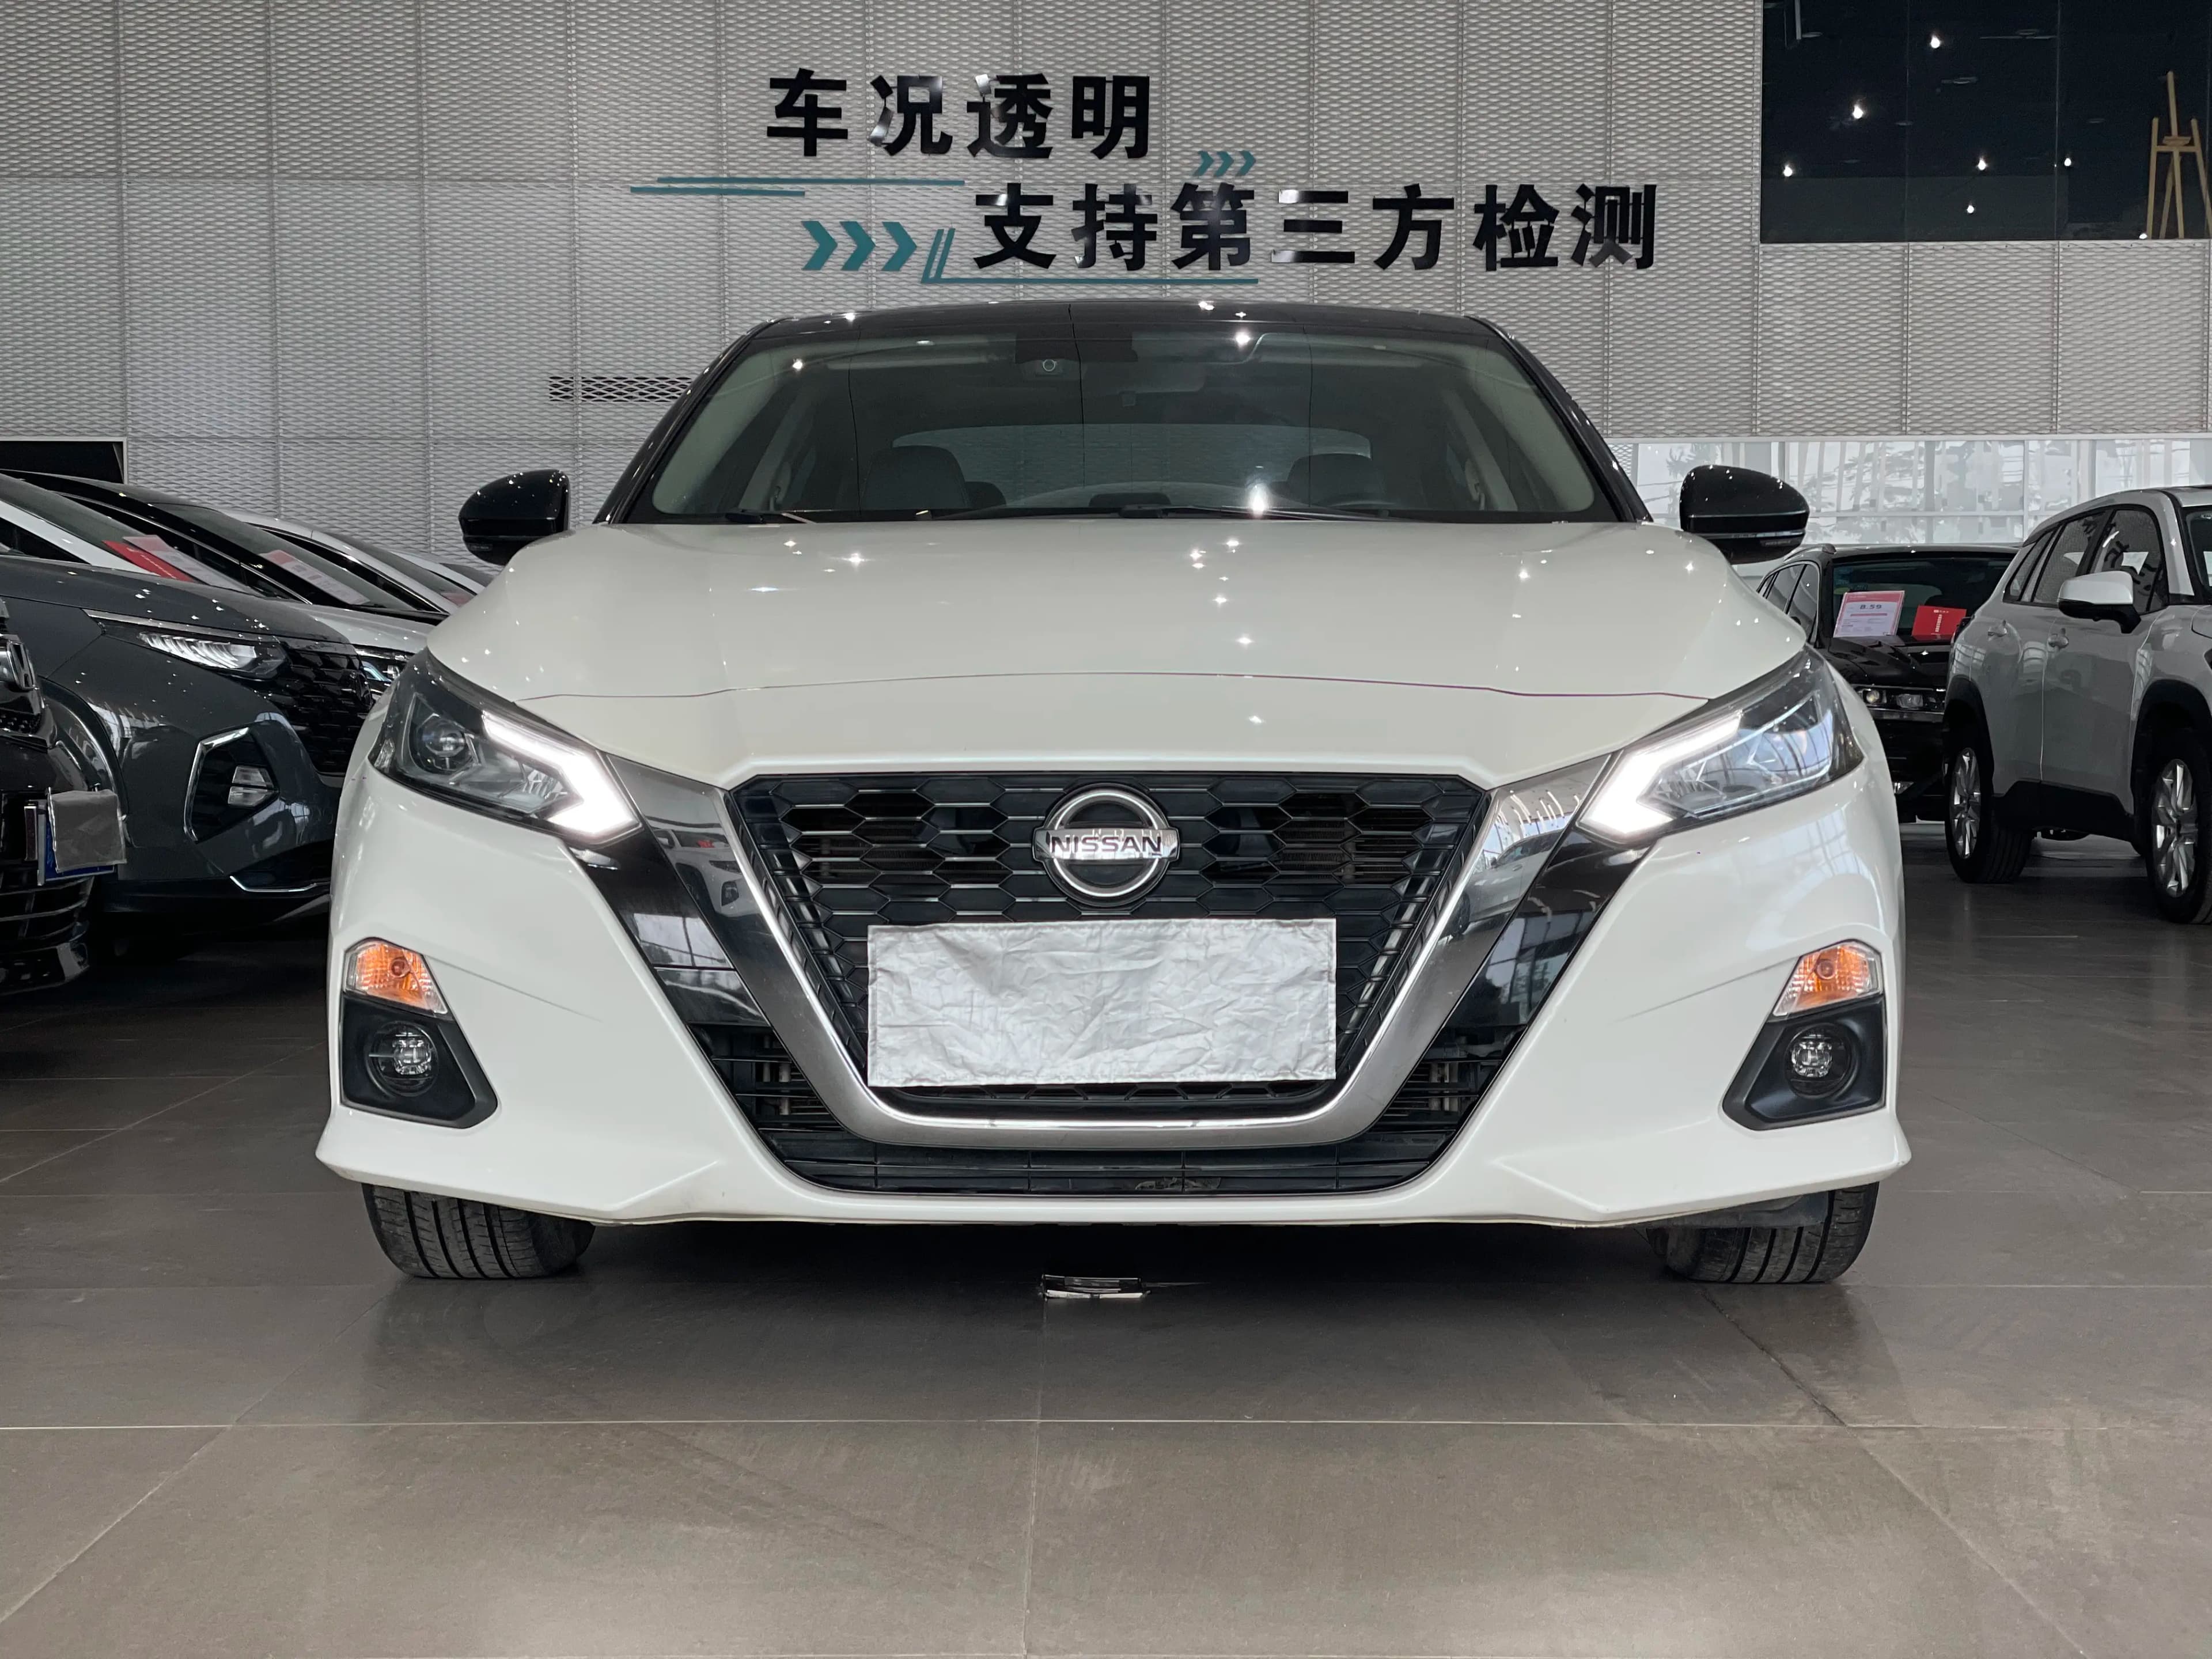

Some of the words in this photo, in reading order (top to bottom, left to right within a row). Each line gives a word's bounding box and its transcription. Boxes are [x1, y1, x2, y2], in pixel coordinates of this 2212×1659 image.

[767, 68, 1150, 159] 车况透明
[974, 183, 1657, 271] 支持第三方检测
[1050, 836, 1162, 853] NISSAN
